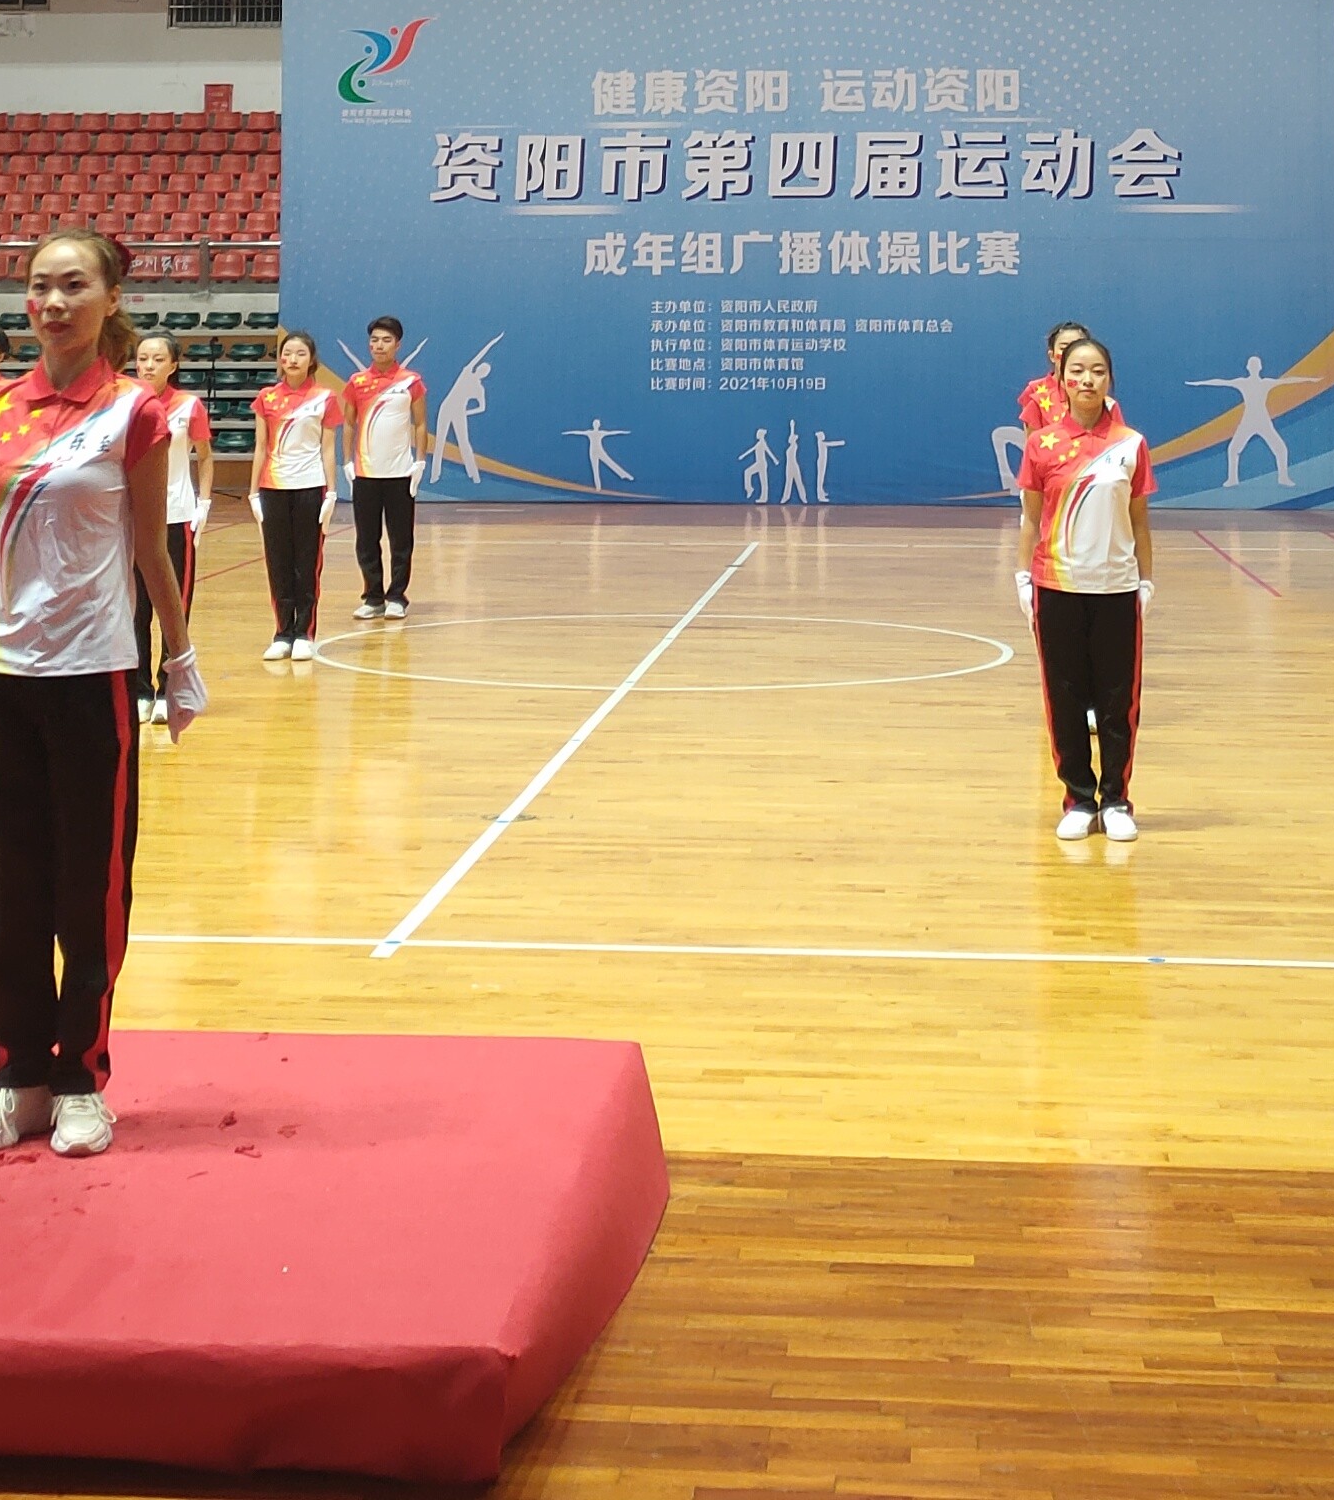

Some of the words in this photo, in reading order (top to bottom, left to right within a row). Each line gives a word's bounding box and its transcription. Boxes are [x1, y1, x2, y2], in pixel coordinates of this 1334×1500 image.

[591, 68, 789, 116] 健康资阳
[819, 67, 1021, 114] 运动资阳
[431, 128, 1182, 201] 资阳市第四届运动会
[584, 230, 1021, 276] 成年组广播体操比赛
[855, 319, 954, 333] 资阳市体育总会
